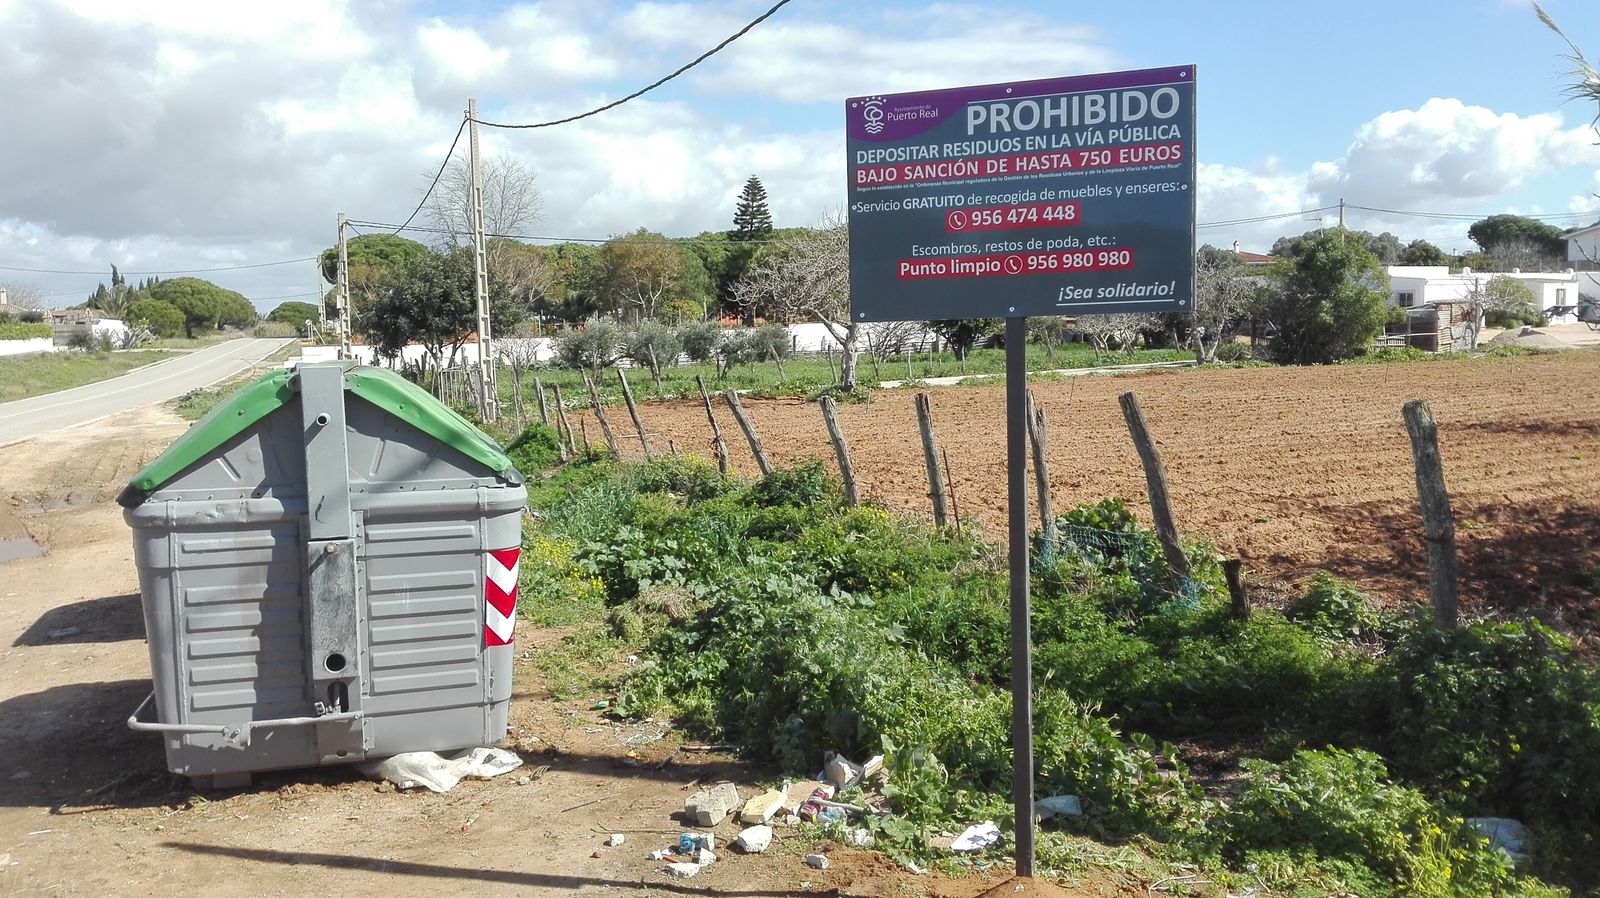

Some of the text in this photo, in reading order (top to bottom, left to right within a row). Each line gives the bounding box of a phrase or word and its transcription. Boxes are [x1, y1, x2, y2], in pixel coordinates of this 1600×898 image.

[888, 108, 938, 121] Puerto Real
[968, 87, 1180, 135] PROHIBIDO
[857, 124, 1181, 164] DEPOSITAR RESIDUOS EN LA VÍA PÚBLICA
[857, 145, 1181, 184] BAJO SANCIÓN DE HASTA 750 EUROS
[857, 182, 1180, 212] Servicio GRATUITO de recogida de muebles y enseres:
[971, 205, 1075, 226] 956 474 448
[912, 235, 1116, 256] Escombros, restos de poda, etc.:
[901, 251, 1130, 276] Punto limpio 956 980 980
[1058, 281, 1176, 301] ¡Sea solidario!
